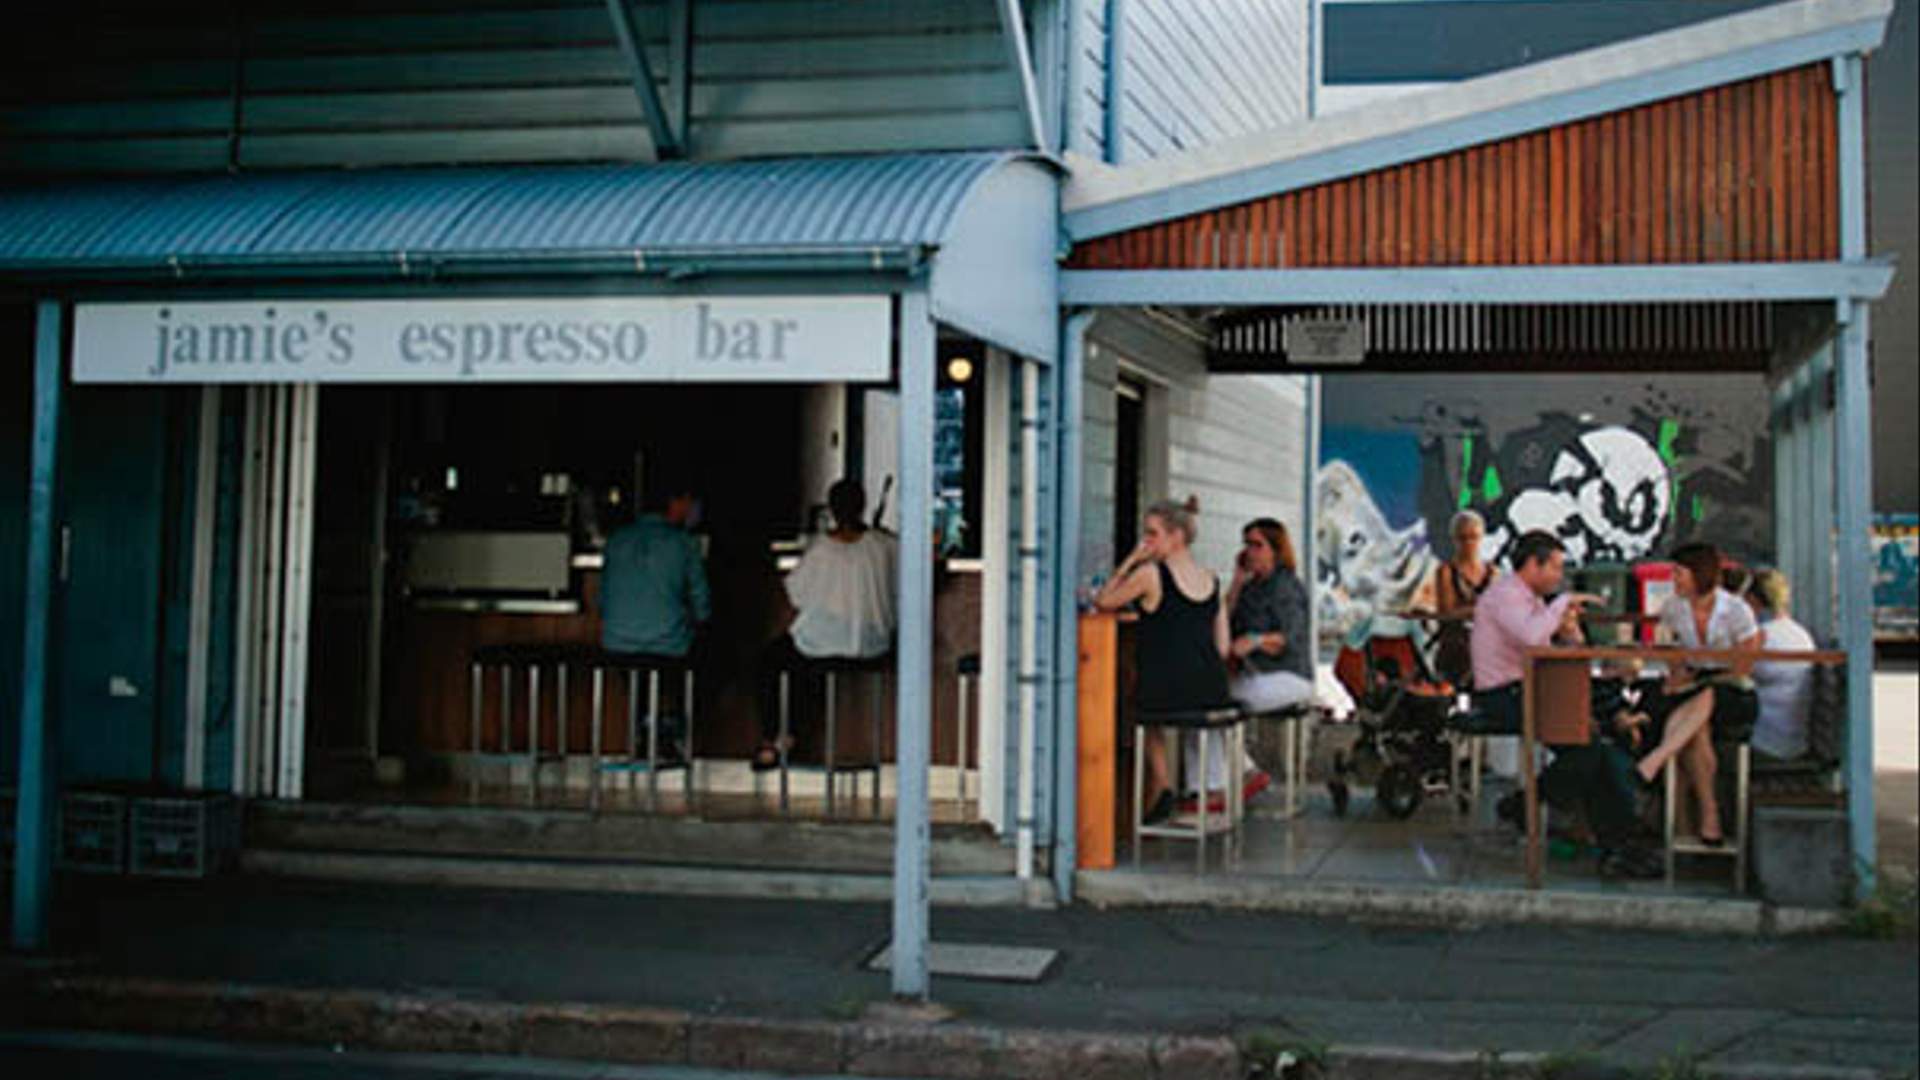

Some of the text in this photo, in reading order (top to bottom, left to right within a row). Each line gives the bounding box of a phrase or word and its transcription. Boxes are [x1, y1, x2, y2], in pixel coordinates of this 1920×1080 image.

[149, 304, 799, 376] jamie's espresso bar
